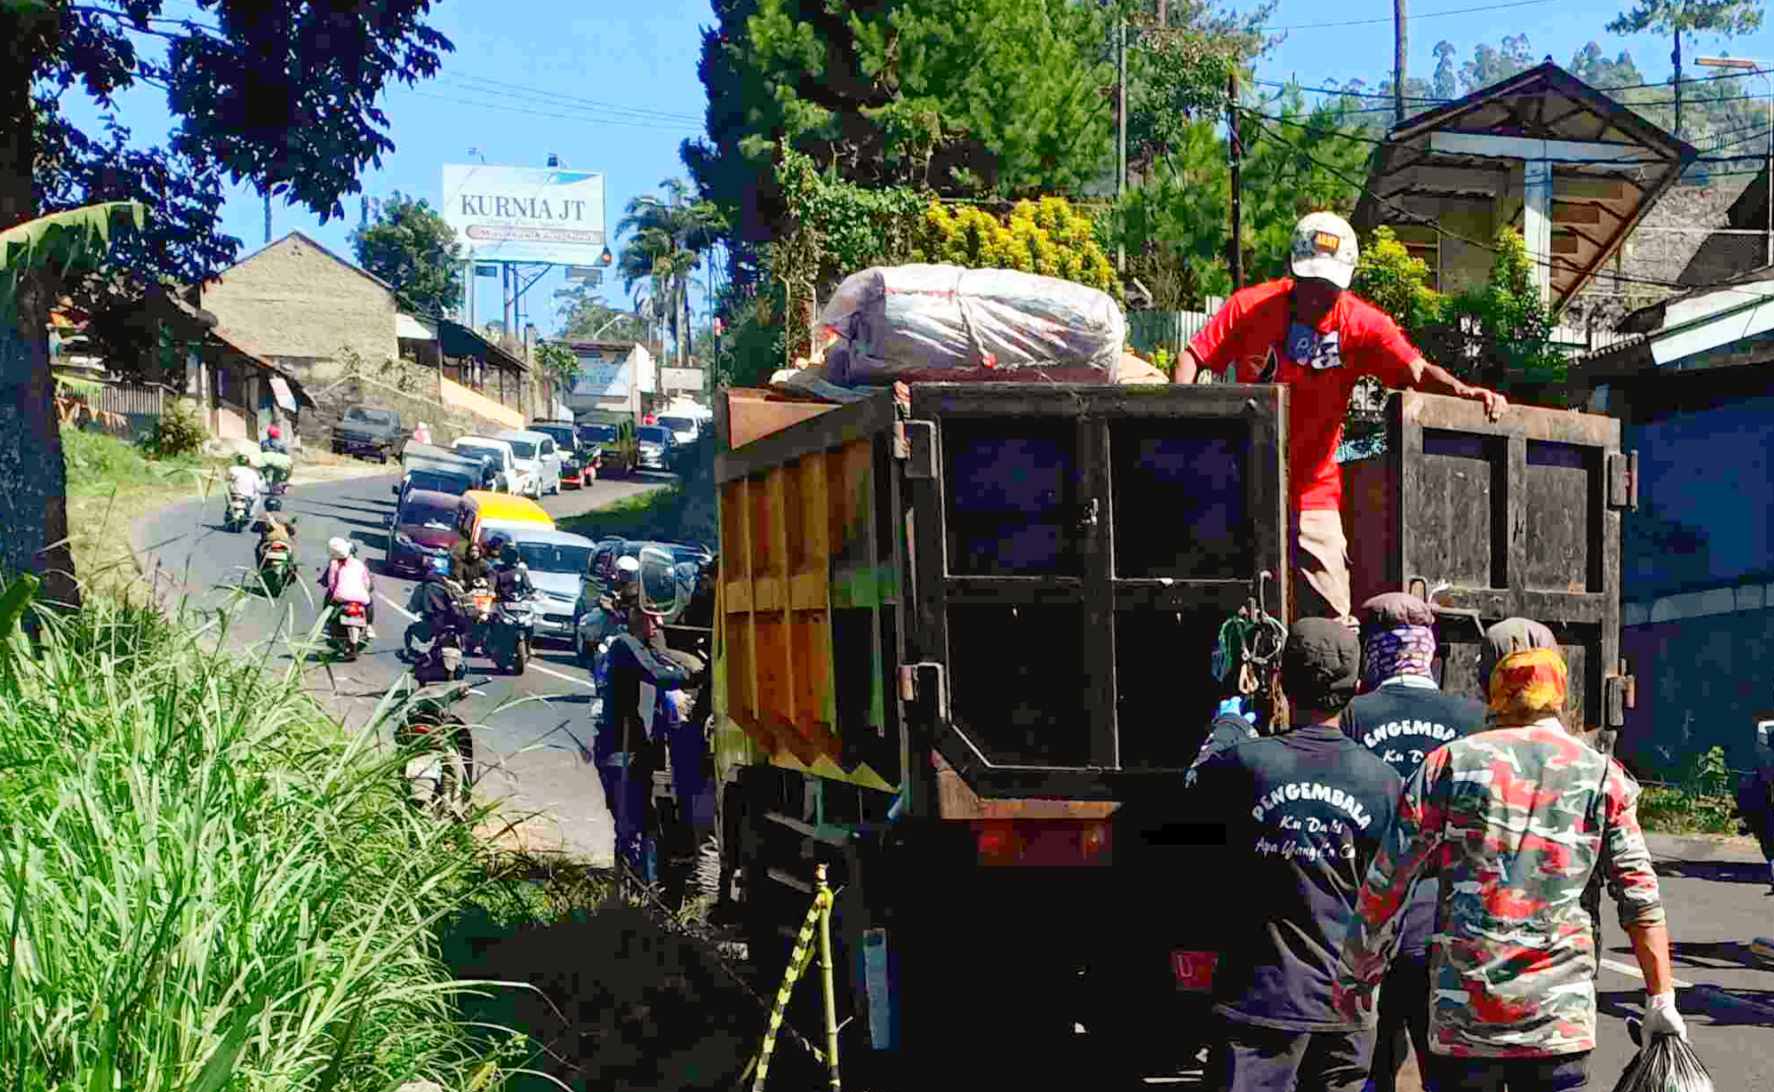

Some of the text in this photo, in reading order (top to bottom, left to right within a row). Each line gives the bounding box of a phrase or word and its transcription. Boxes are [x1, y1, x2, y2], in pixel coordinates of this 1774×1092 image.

[461, 194, 585, 221] KURNIA JT
[1363, 720, 1457, 748] ENGEMBA
[1252, 782, 1372, 830] PENGEMBALA
[1280, 815, 1302, 830] Ku
